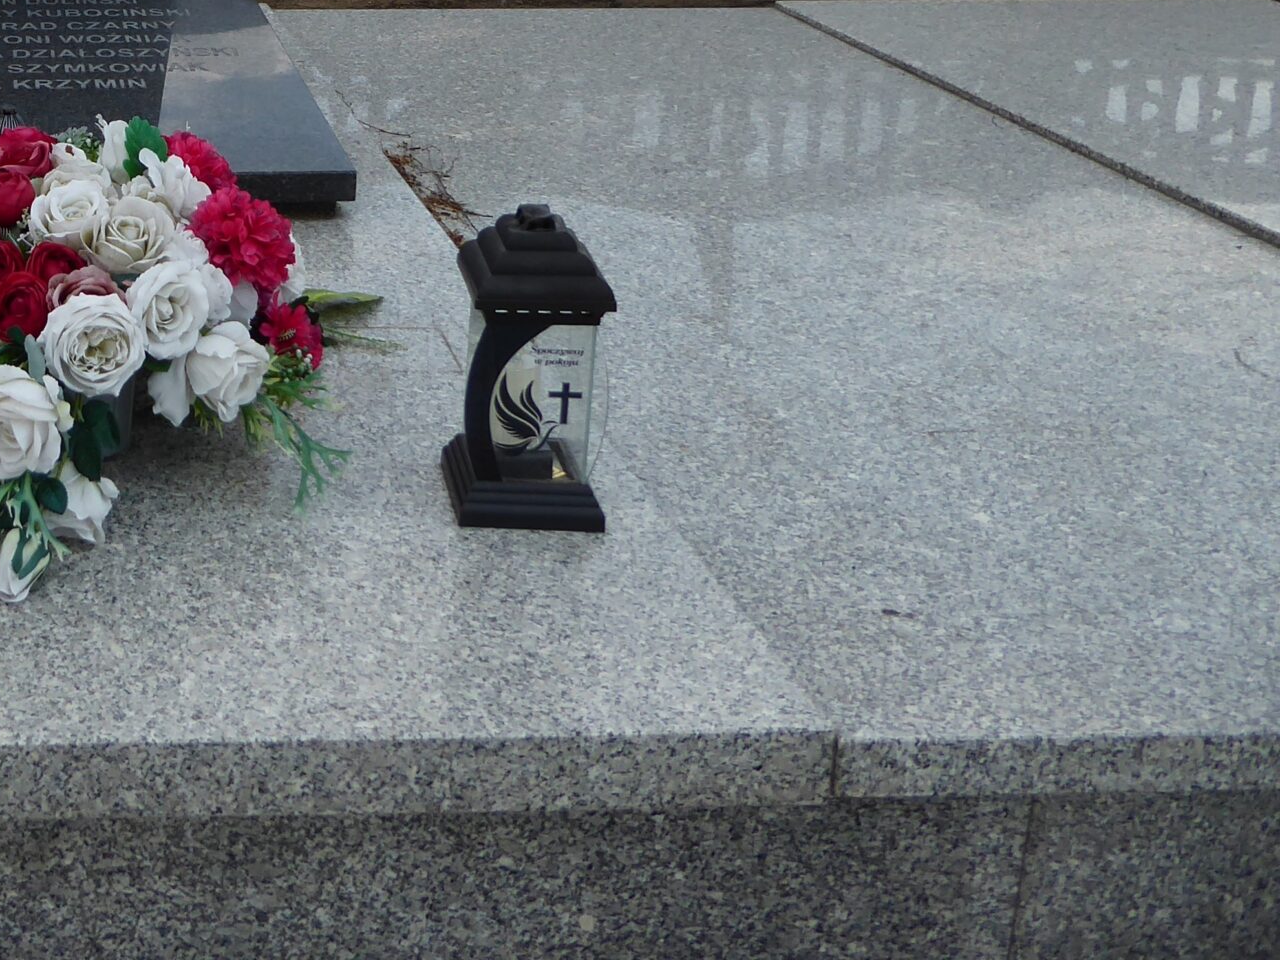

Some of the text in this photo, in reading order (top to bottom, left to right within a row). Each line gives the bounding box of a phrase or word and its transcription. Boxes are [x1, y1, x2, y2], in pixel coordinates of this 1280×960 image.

[66, 20, 176, 31] CZARNY
[7, 62, 210, 75] SZYMKOWIAK
[12, 76, 148, 90] KRZYMIŃ
